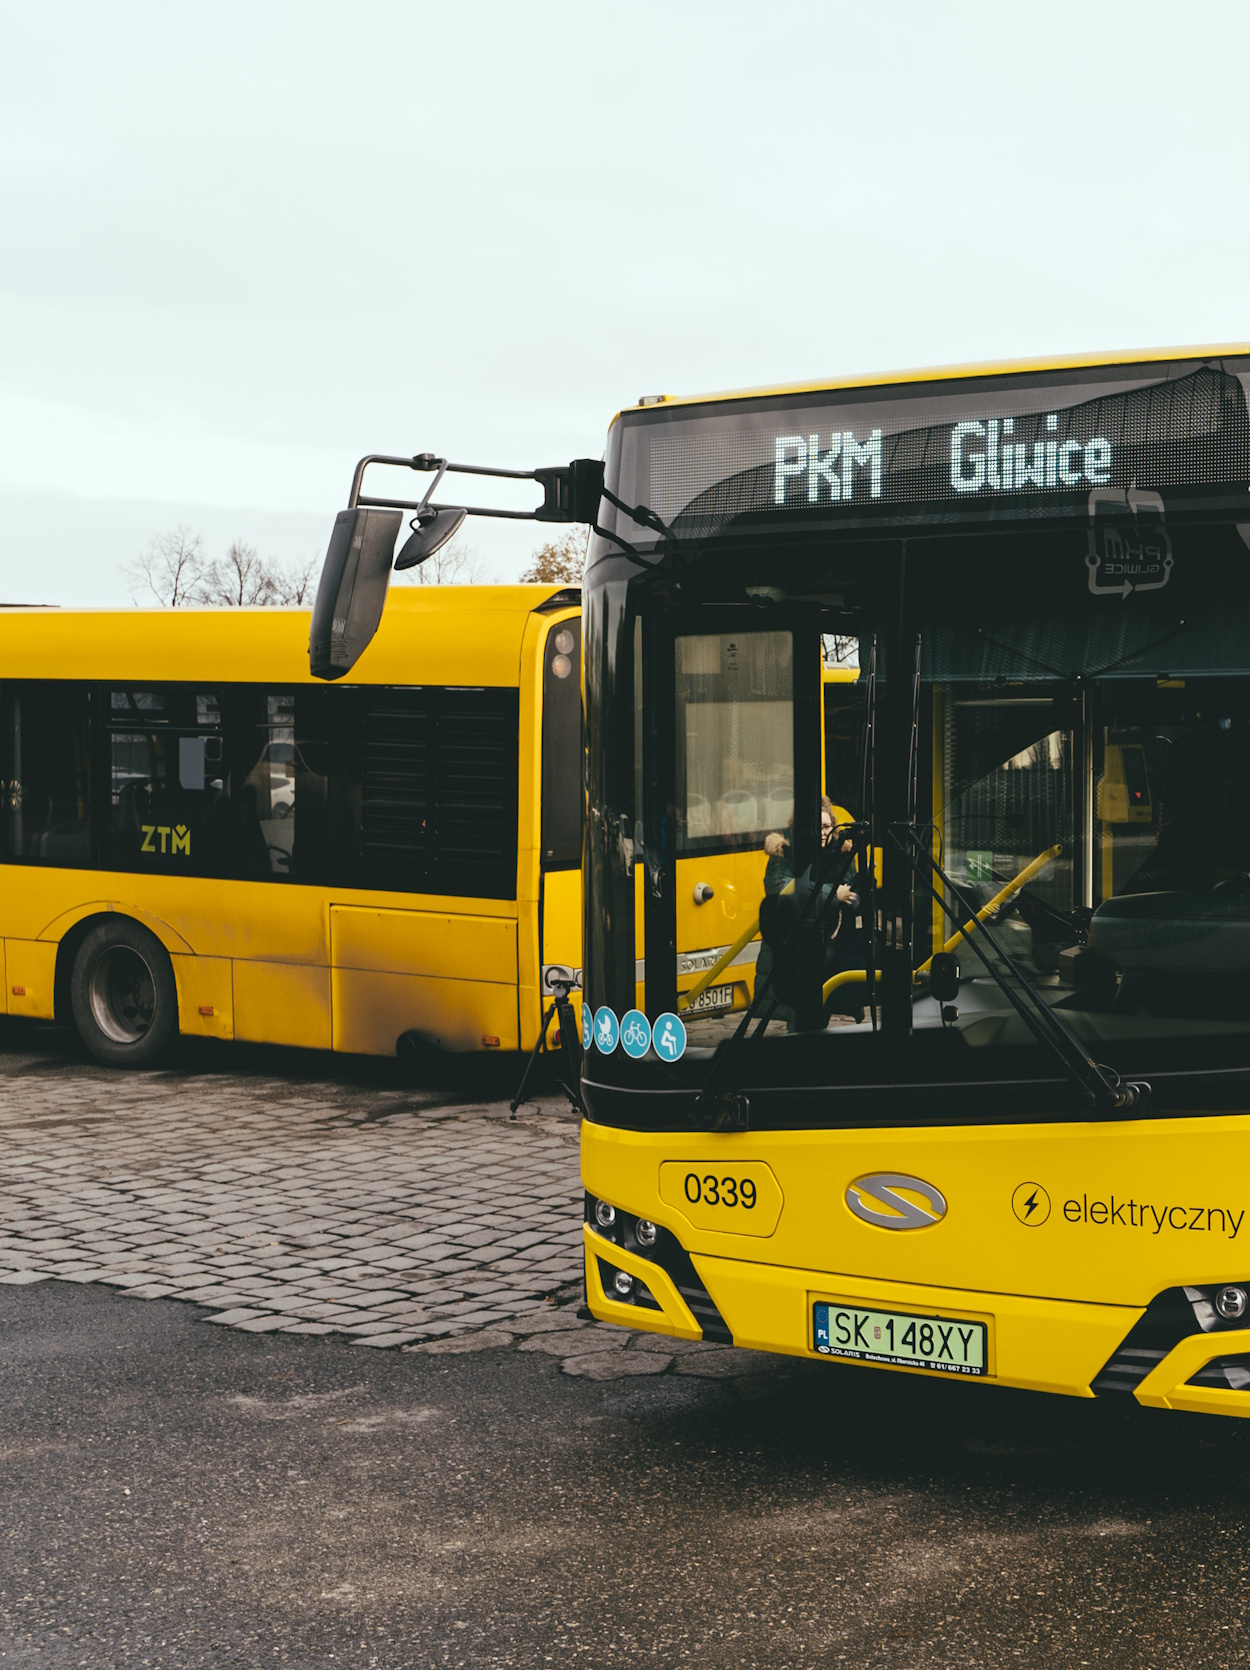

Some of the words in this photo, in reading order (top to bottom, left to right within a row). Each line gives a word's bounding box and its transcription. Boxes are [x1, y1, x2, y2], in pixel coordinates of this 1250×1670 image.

[774, 429, 882, 504] PKM
[951, 415, 1112, 493] Gliwice
[141, 824, 191, 856] ZTM
[698, 986, 731, 1007] 8501F
[684, 1172, 757, 1211] 0339
[1063, 1193, 1245, 1239] elektryczny
[818, 1329, 828, 1339] PL
[835, 1312, 870, 1349] SK
[885, 1318, 974, 1362] 148XY
[830, 1347, 861, 1358] SOLARIS
